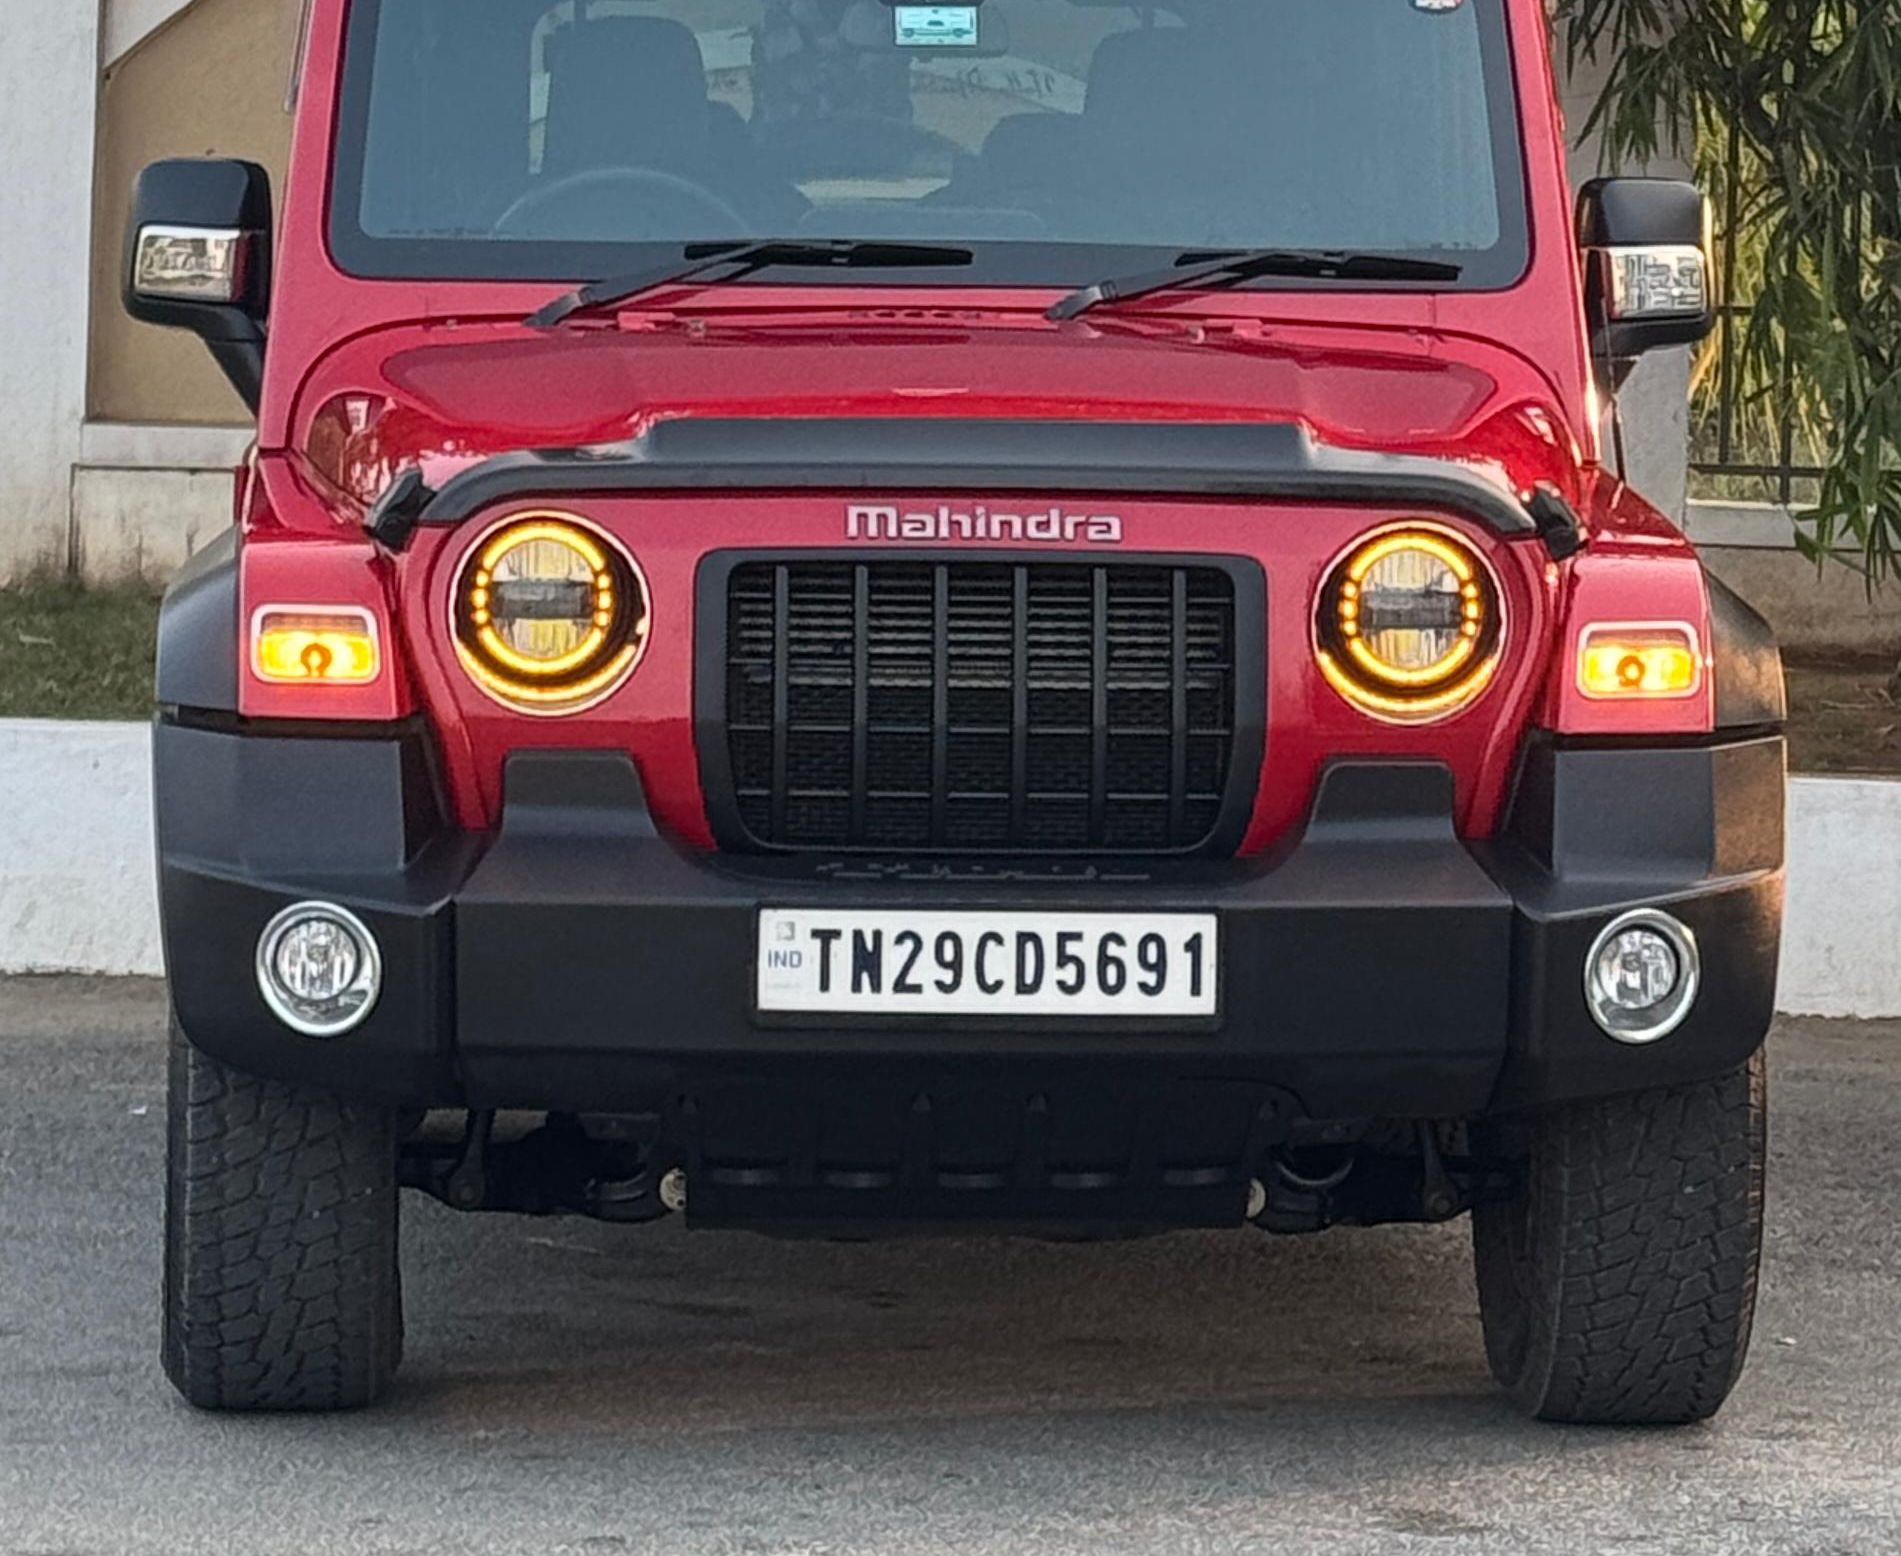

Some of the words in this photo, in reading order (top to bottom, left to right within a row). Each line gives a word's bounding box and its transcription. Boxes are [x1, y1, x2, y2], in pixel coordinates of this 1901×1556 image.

[847, 505, 1122, 541] Mahindra
[767, 949, 803, 969] IND
[810, 928, 1204, 997] TN29CD5691
